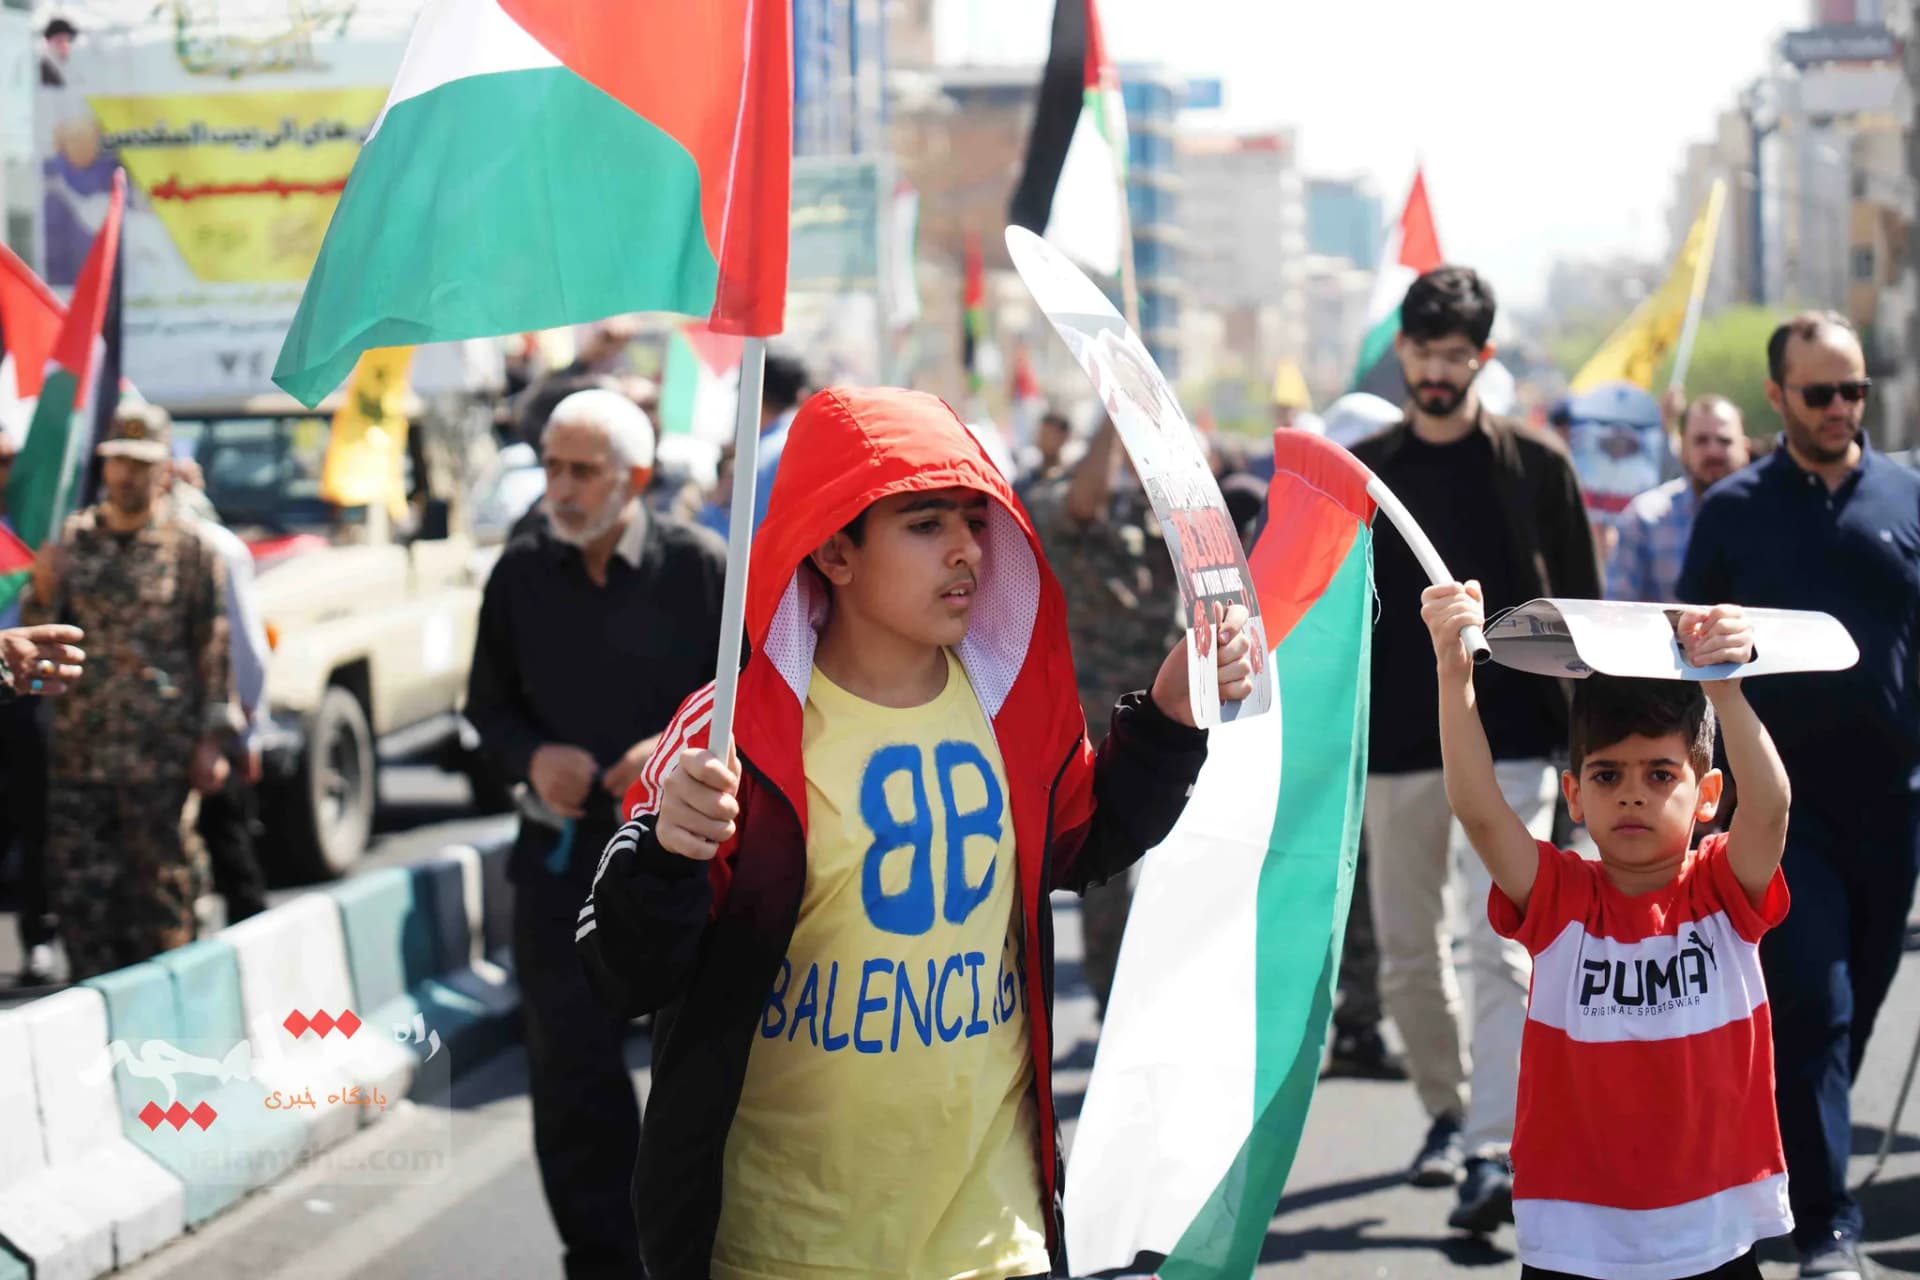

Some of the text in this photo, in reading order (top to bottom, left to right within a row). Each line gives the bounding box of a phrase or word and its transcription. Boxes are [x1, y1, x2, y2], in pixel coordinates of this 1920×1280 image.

[1171, 508, 1235, 569] BLOOD
[761, 950, 1027, 1054] BALENCIG
[1579, 947, 1708, 1006] PUMA
[1583, 1004, 1633, 1017] ORIGINAL
